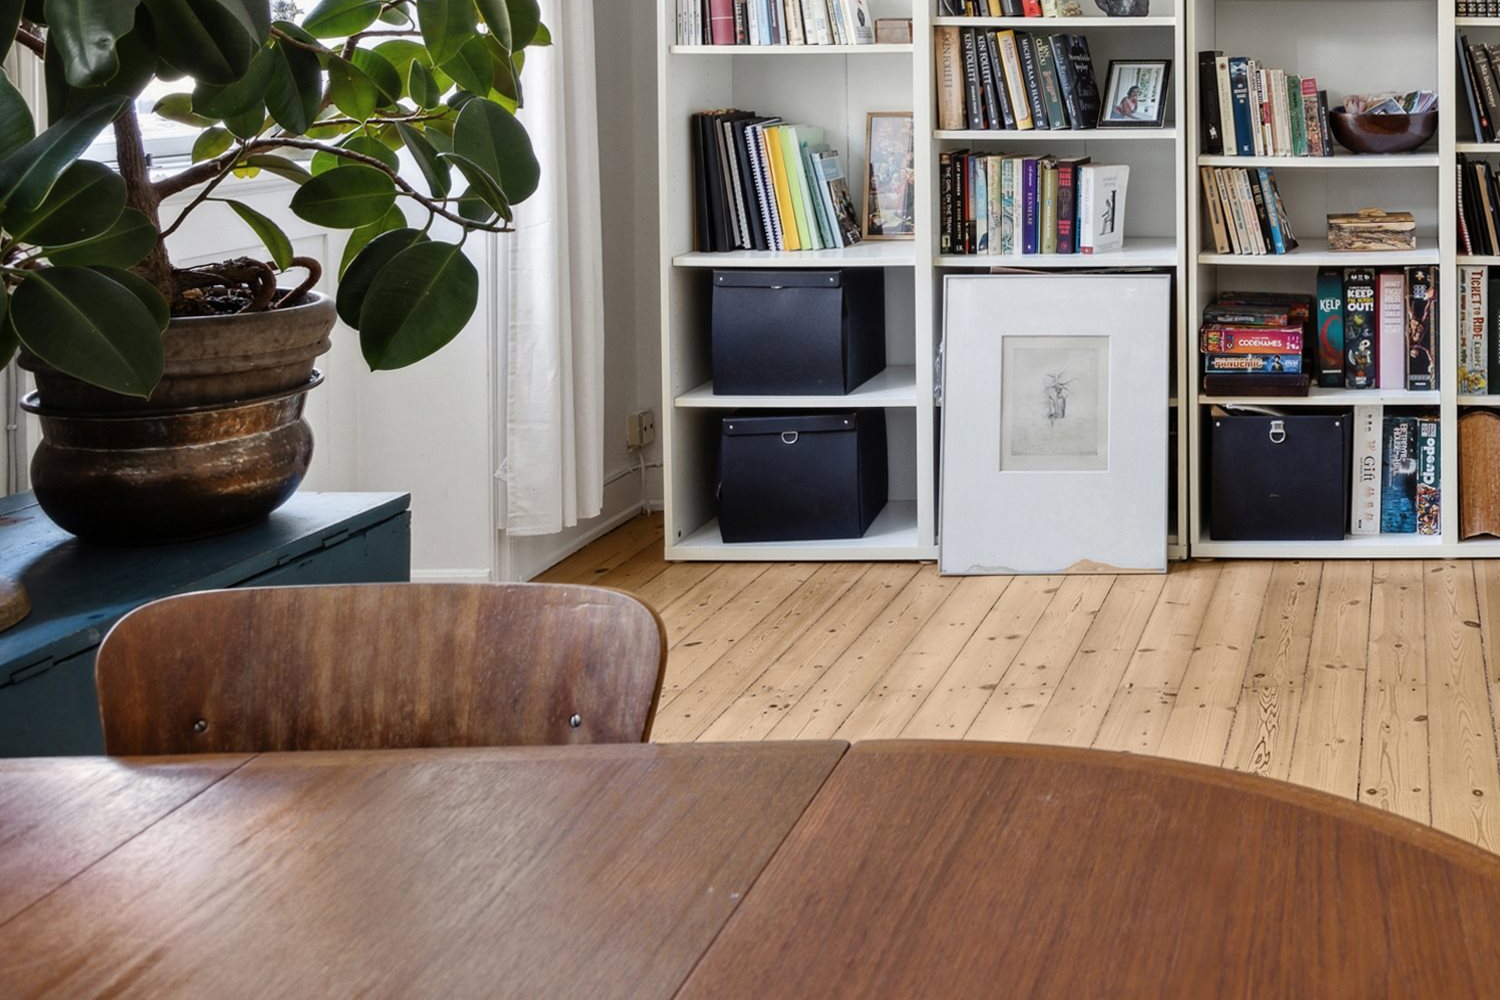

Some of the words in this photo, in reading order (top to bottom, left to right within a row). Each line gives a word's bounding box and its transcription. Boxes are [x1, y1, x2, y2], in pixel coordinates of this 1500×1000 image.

[964, 33, 973, 49] KEN
[977, 35, 986, 51] KEN
[966, 51, 976, 82] FOLLETT
[981, 53, 992, 84] FOLLETT
[1347, 289, 1374, 298] KEEP
[1471, 270, 1484, 305] TICKET
[1320, 298, 1341, 313] KELP
[1347, 302, 1374, 312] OUT!
[1474, 306, 1481, 316] TO
[1472, 317, 1484, 340] RIDE
[1238, 339, 1283, 347] CODENAMES
[1422, 437, 1436, 484] cluedo
[1363, 456, 1377, 482] Gift
